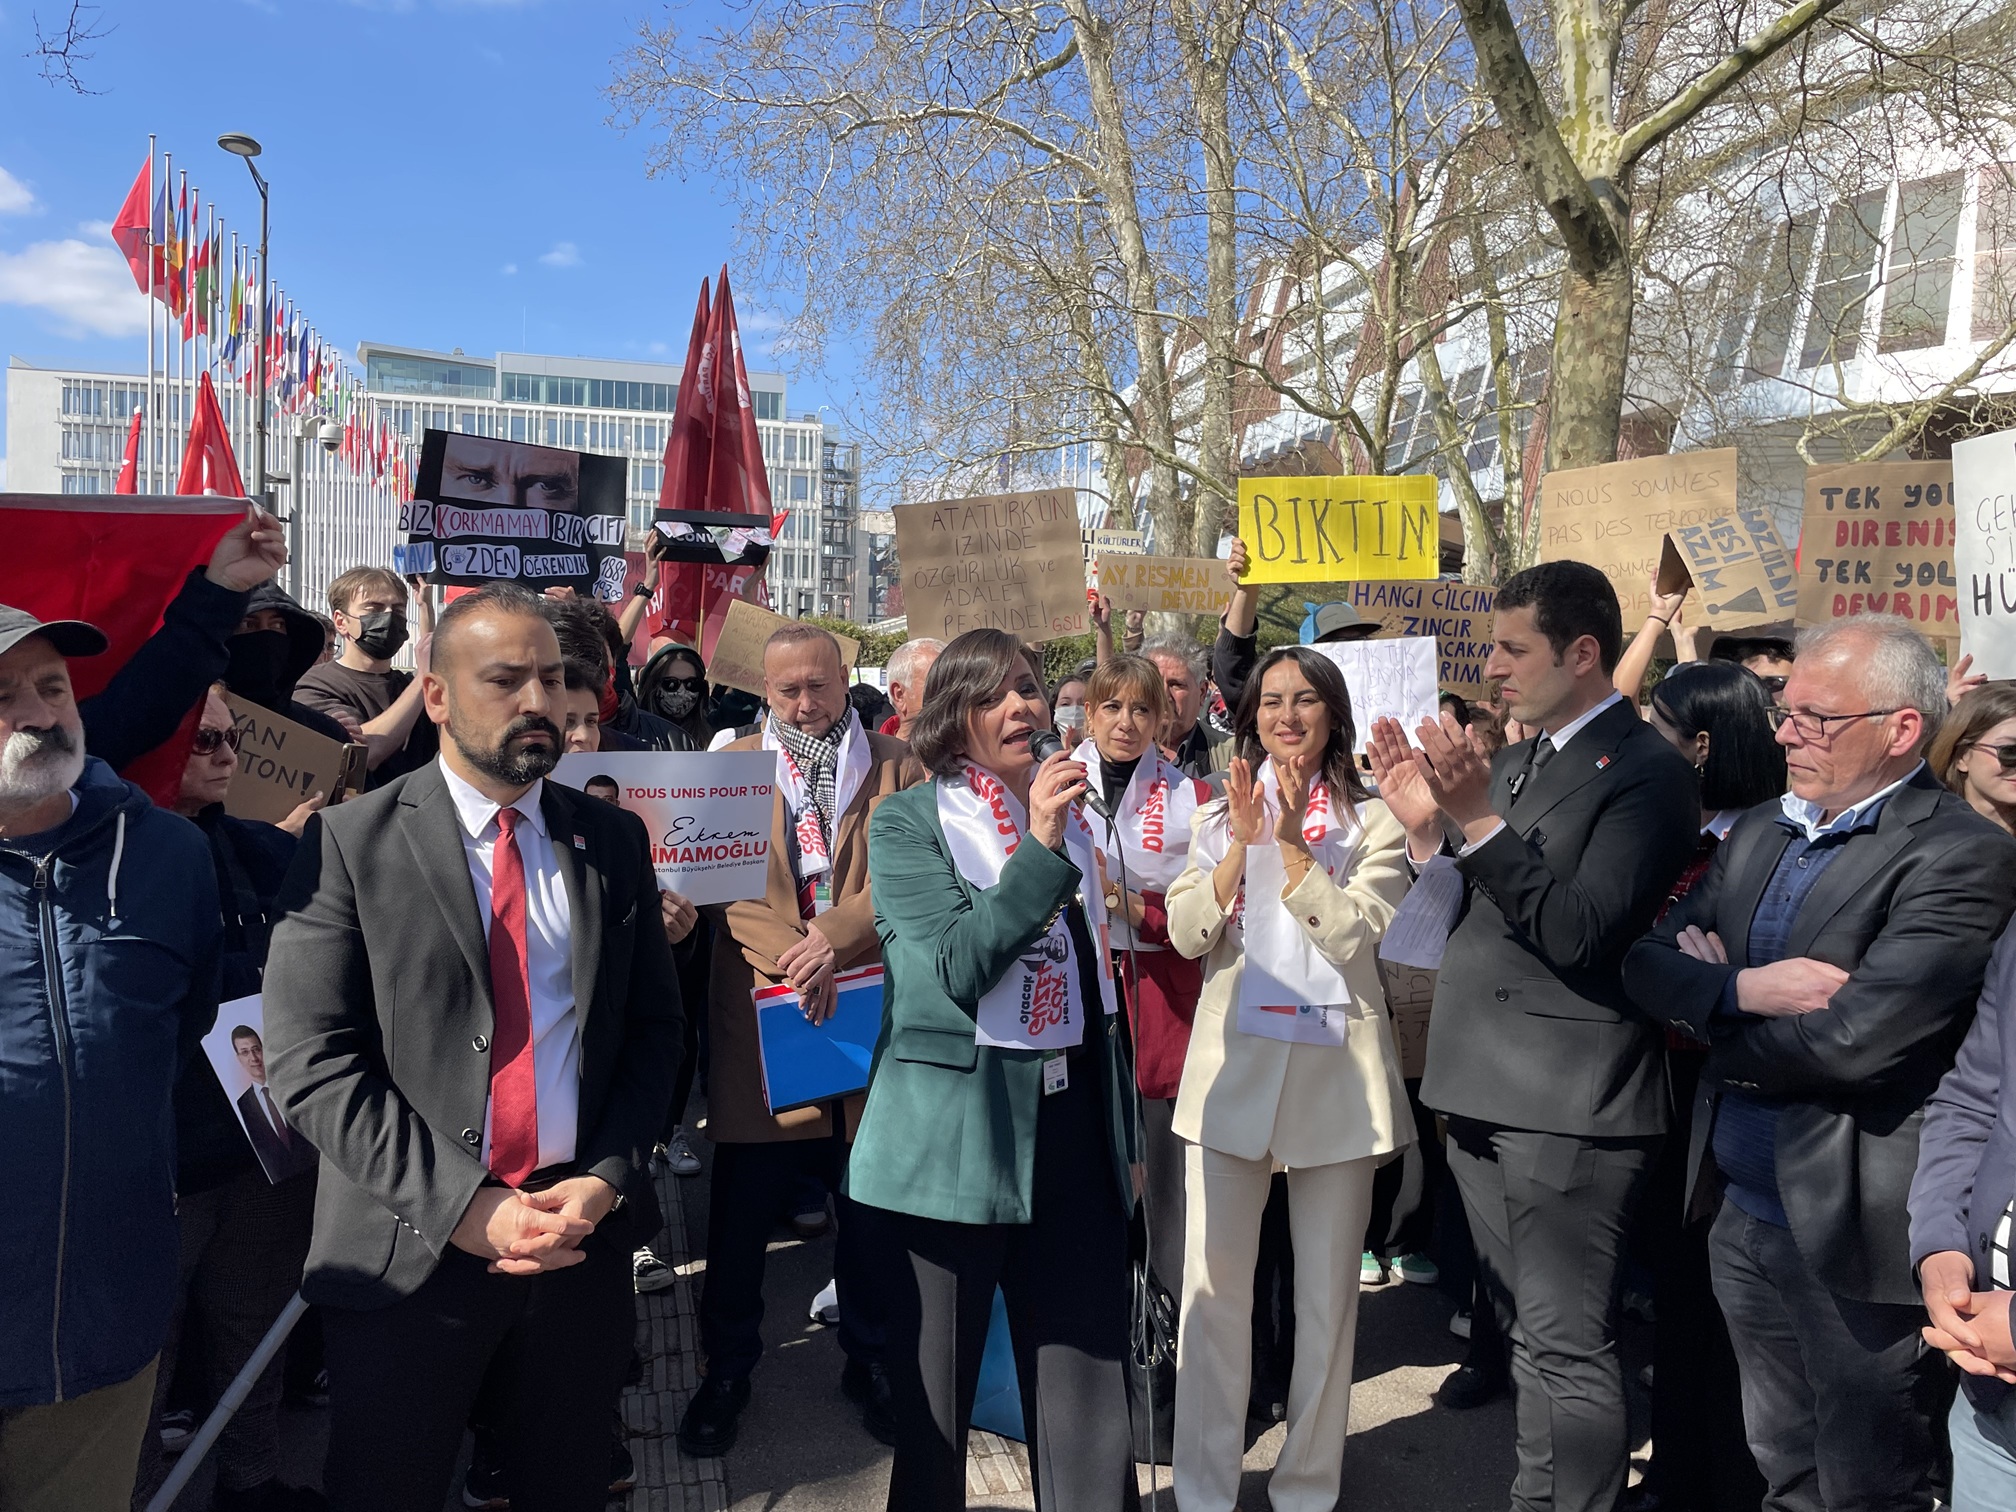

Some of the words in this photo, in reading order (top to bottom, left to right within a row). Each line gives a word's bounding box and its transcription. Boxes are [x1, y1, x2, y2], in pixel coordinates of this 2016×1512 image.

[1557, 483, 1612, 508] NOUS
[1631, 470, 1722, 498] SOMMES
[1820, 486, 1880, 511] TEK
[437, 507, 549, 538] KORKMAMAYI
[932, 492, 1068, 531] ATATÜRK'ÜN
[1254, 494, 1430, 564] BIKTIM
[1548, 523, 1582, 547] PAS
[1595, 518, 1632, 541] DES
[602, 557, 627, 583] 1881
[914, 554, 1027, 589] ÖZGÜRLÜK
[1038, 560, 1055, 573] ve
[1135, 565, 1209, 589] RESMEN
[1815, 559, 1871, 584] TEK
[1893, 561, 1957, 587] YOL
[944, 582, 1028, 607] ADALET
[1052, 612, 1082, 632] GSÜ
[626, 788, 666, 799] TOUS
[671, 787, 706, 798] UNIS
[709, 786, 748, 797] POUR
[751, 785, 772, 796] TOI
[653, 840, 767, 864] İMAMOĞLU
[716, 861, 741, 869] Belediye
